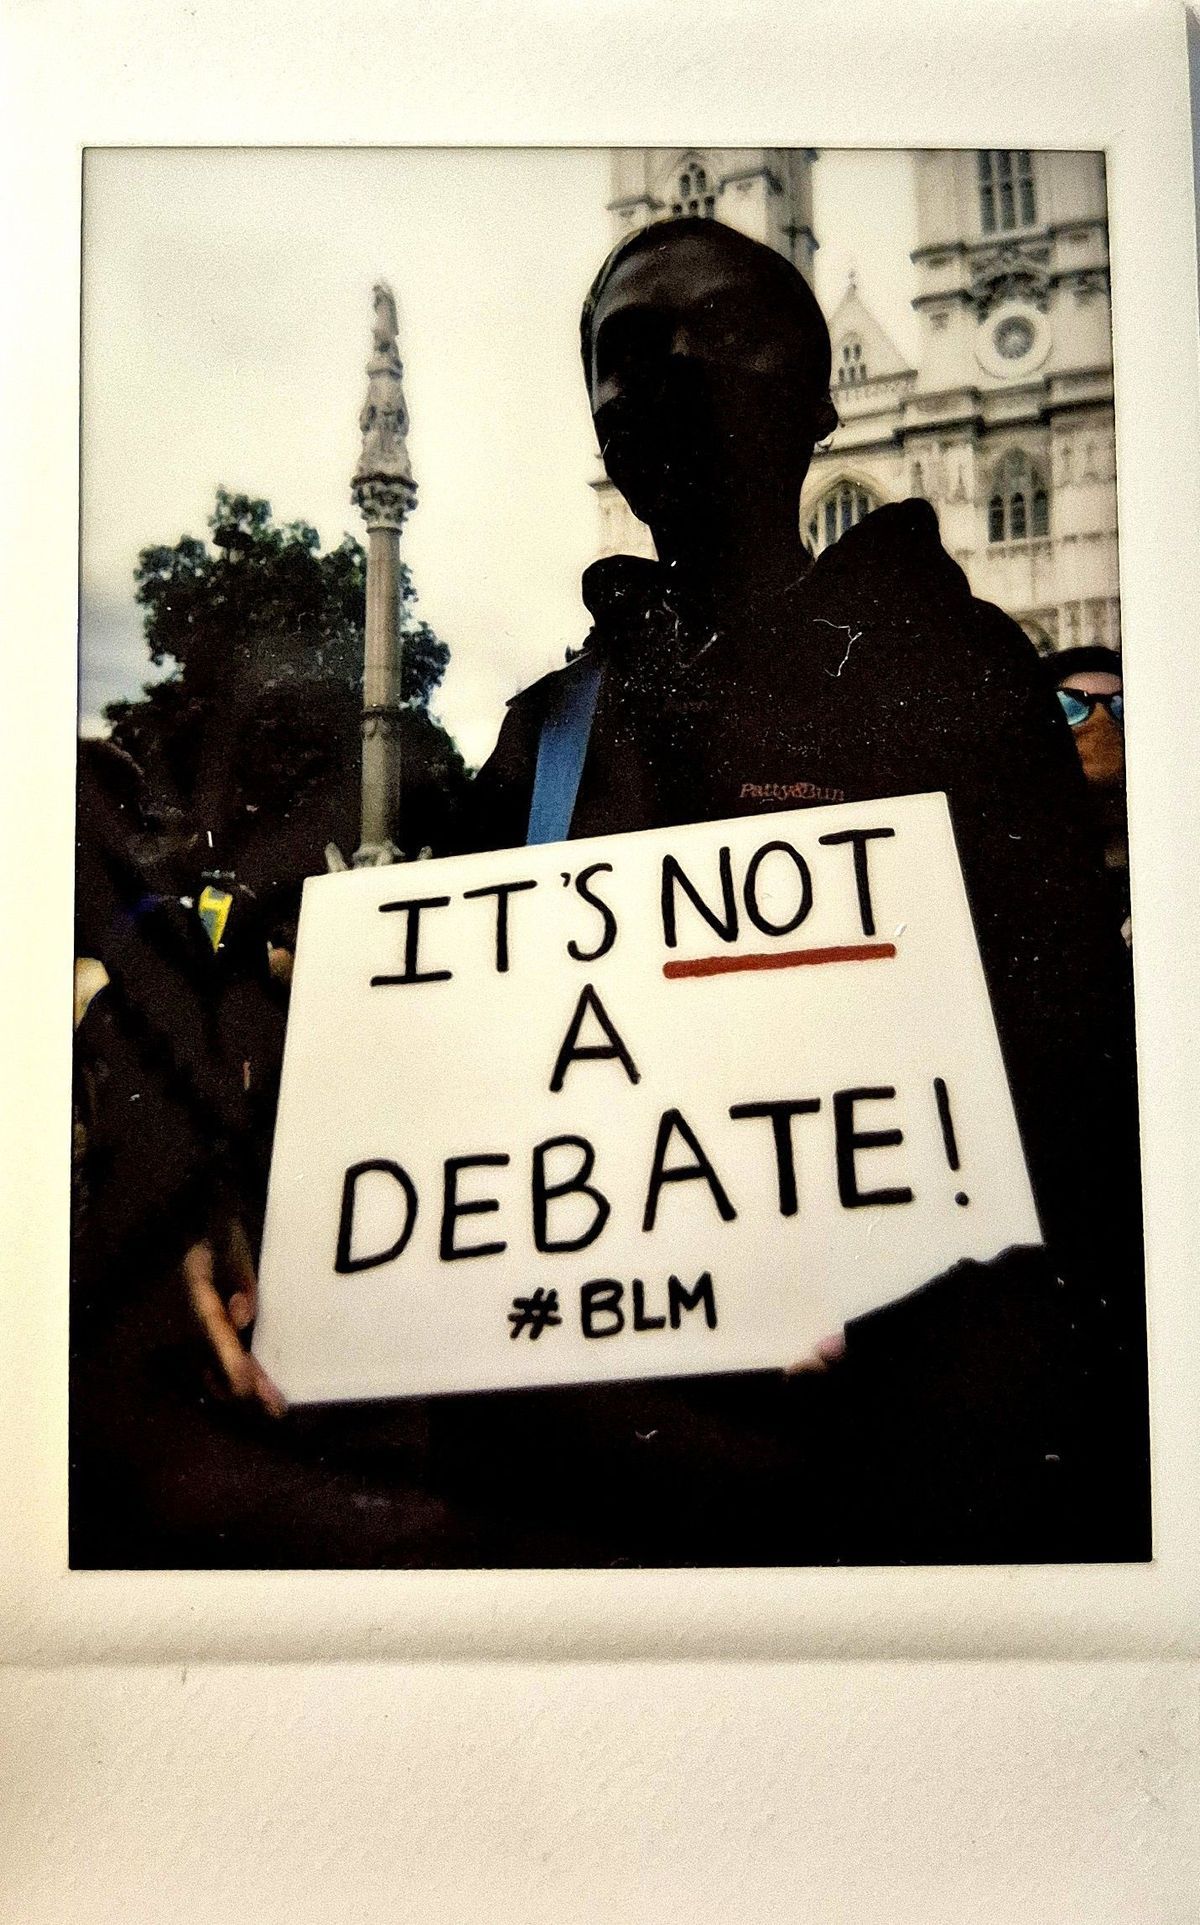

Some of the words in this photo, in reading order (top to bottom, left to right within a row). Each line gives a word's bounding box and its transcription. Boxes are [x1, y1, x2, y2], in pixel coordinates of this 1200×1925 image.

[371, 863, 617, 987] IT'S
[661, 828, 895, 948] NOT
[550, 984, 640, 1092] A
[334, 1078, 969, 1274] DEBATE!
[508, 1272, 717, 1340] #BLM
